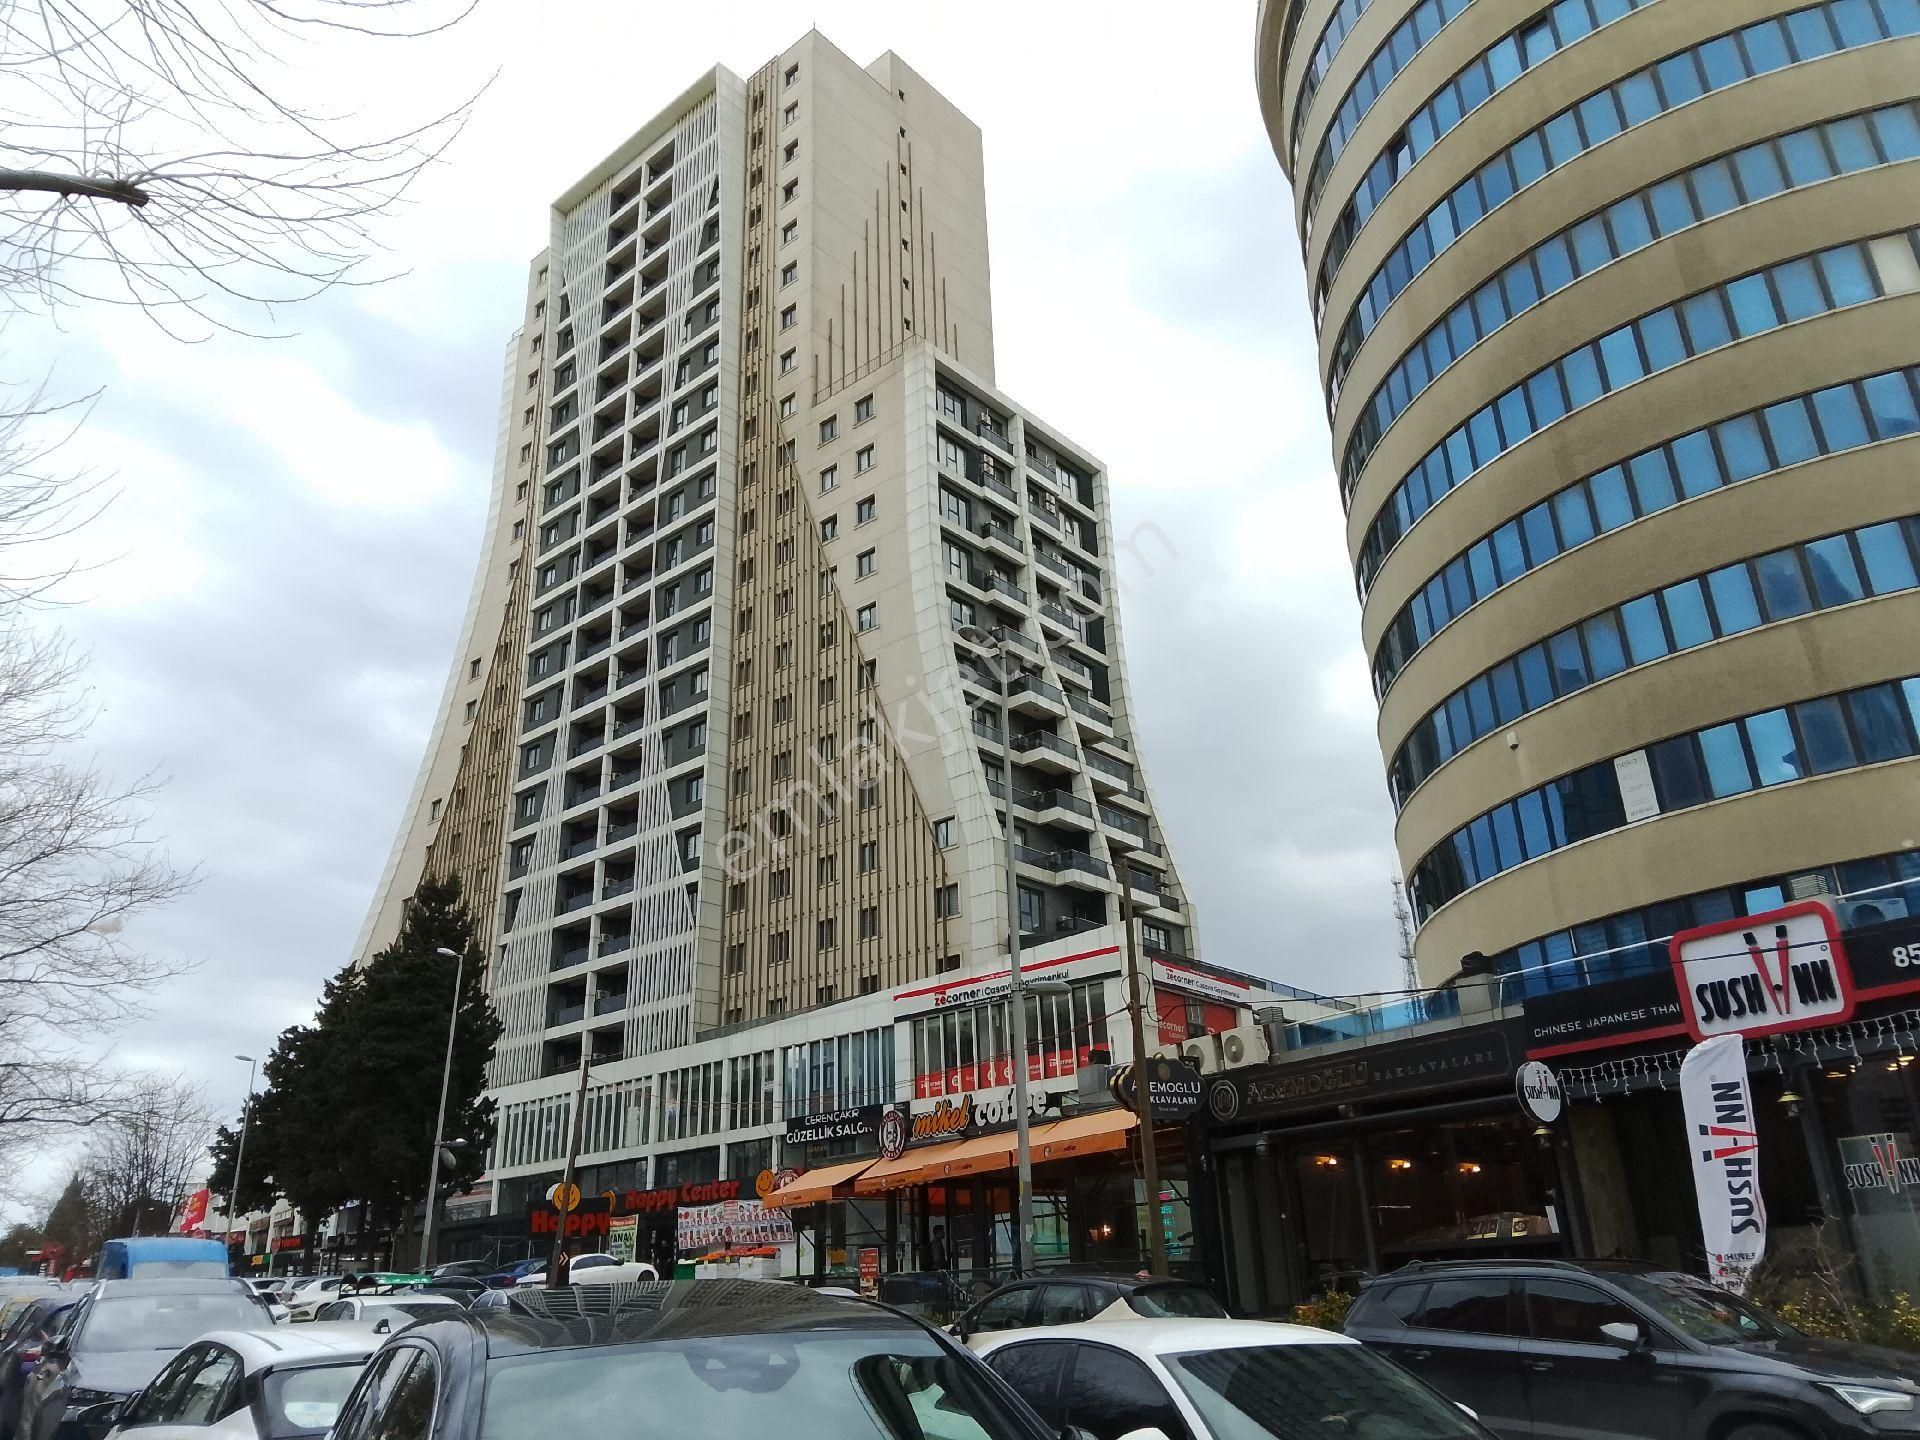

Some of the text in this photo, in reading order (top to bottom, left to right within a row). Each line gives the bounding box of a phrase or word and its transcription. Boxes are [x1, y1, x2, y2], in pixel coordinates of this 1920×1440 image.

[1534, 1002, 1681, 1038] CHINESE JAPANESE THAI
[913, 1094, 973, 1140] mikel
[1149, 1095, 1197, 1105] KLAVALARI
[624, 1180, 740, 1212] Happy Center
